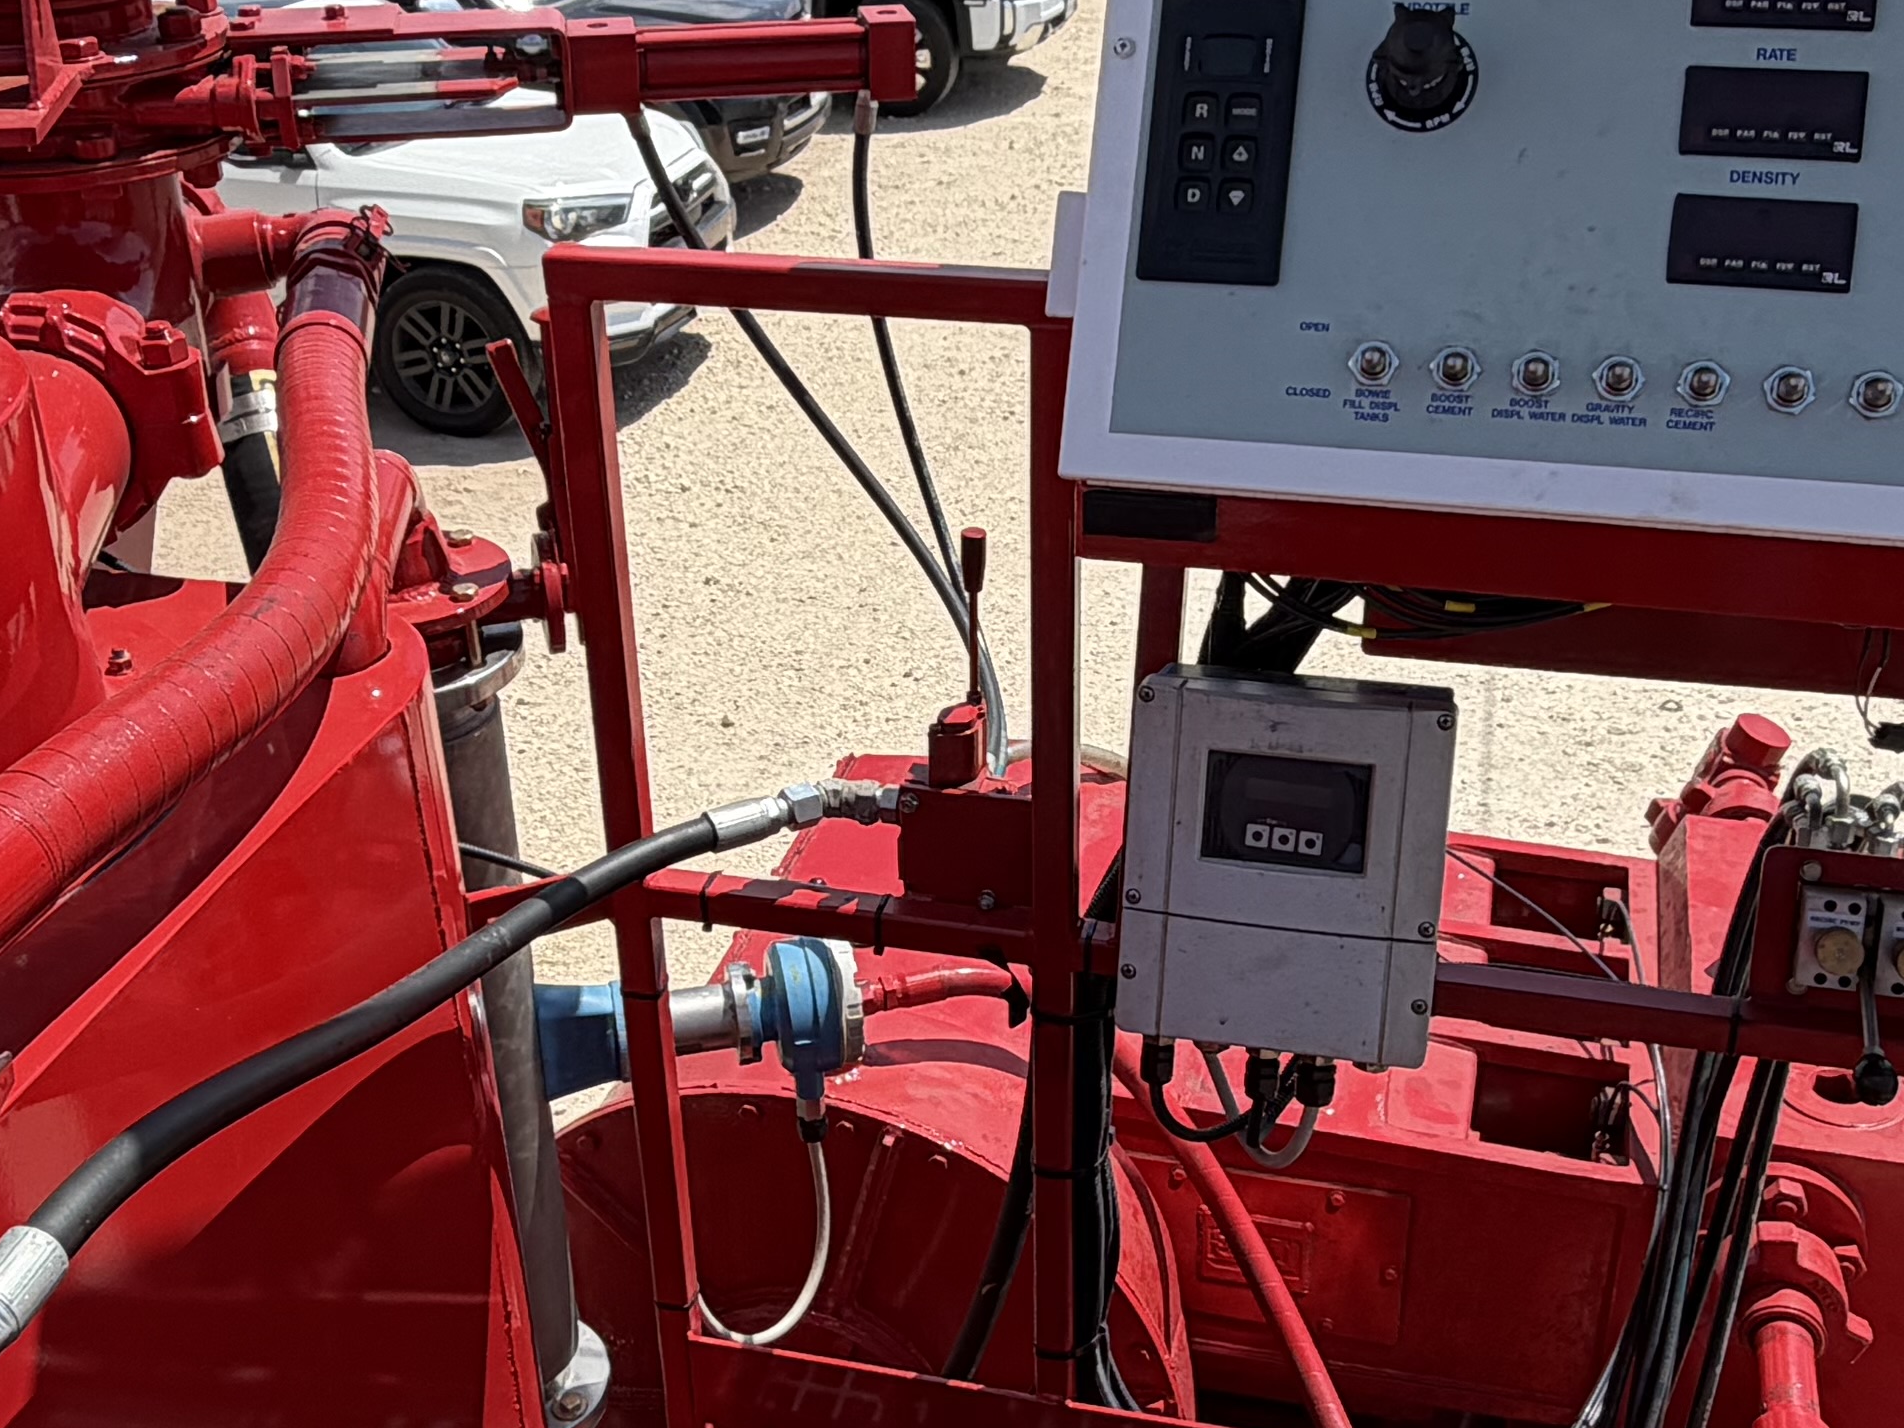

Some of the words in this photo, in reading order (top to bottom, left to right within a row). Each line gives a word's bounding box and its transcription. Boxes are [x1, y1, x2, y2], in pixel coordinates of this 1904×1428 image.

[1757, 47, 1797, 61] RATE
[1195, 103, 1208, 118] R
[1232, 107, 1257, 116] MODE
[1425, 113, 1450, 129] RPM
[1191, 145, 1205, 160] N
[1729, 170, 1800, 185] DENSITY
[1187, 188, 1200, 203] D
[1300, 322, 1330, 332] OPEN
[1286, 386, 1331, 399] CLOSED
[1355, 388, 1391, 399] BOWIE
[1430, 393, 1470, 404] BOOST
[1343, 399, 1365, 409] FILL
[1369, 400, 1400, 412] DISPL
[1509, 398, 1549, 409] BOOST
[1586, 402, 1635, 415] GRAVITY
[1354, 410, 1389, 422] TANKS
[1426, 405, 1473, 417] CEMENT
[1491, 409, 1524, 420] DISPL
[1528, 411, 1566, 422] WATER
[1669, 407, 1714, 419] RECIRC
[1571, 413, 1604, 425] DISPL
[1609, 416, 1647, 427] WATER
[1666, 420, 1716, 432] CEMENT
